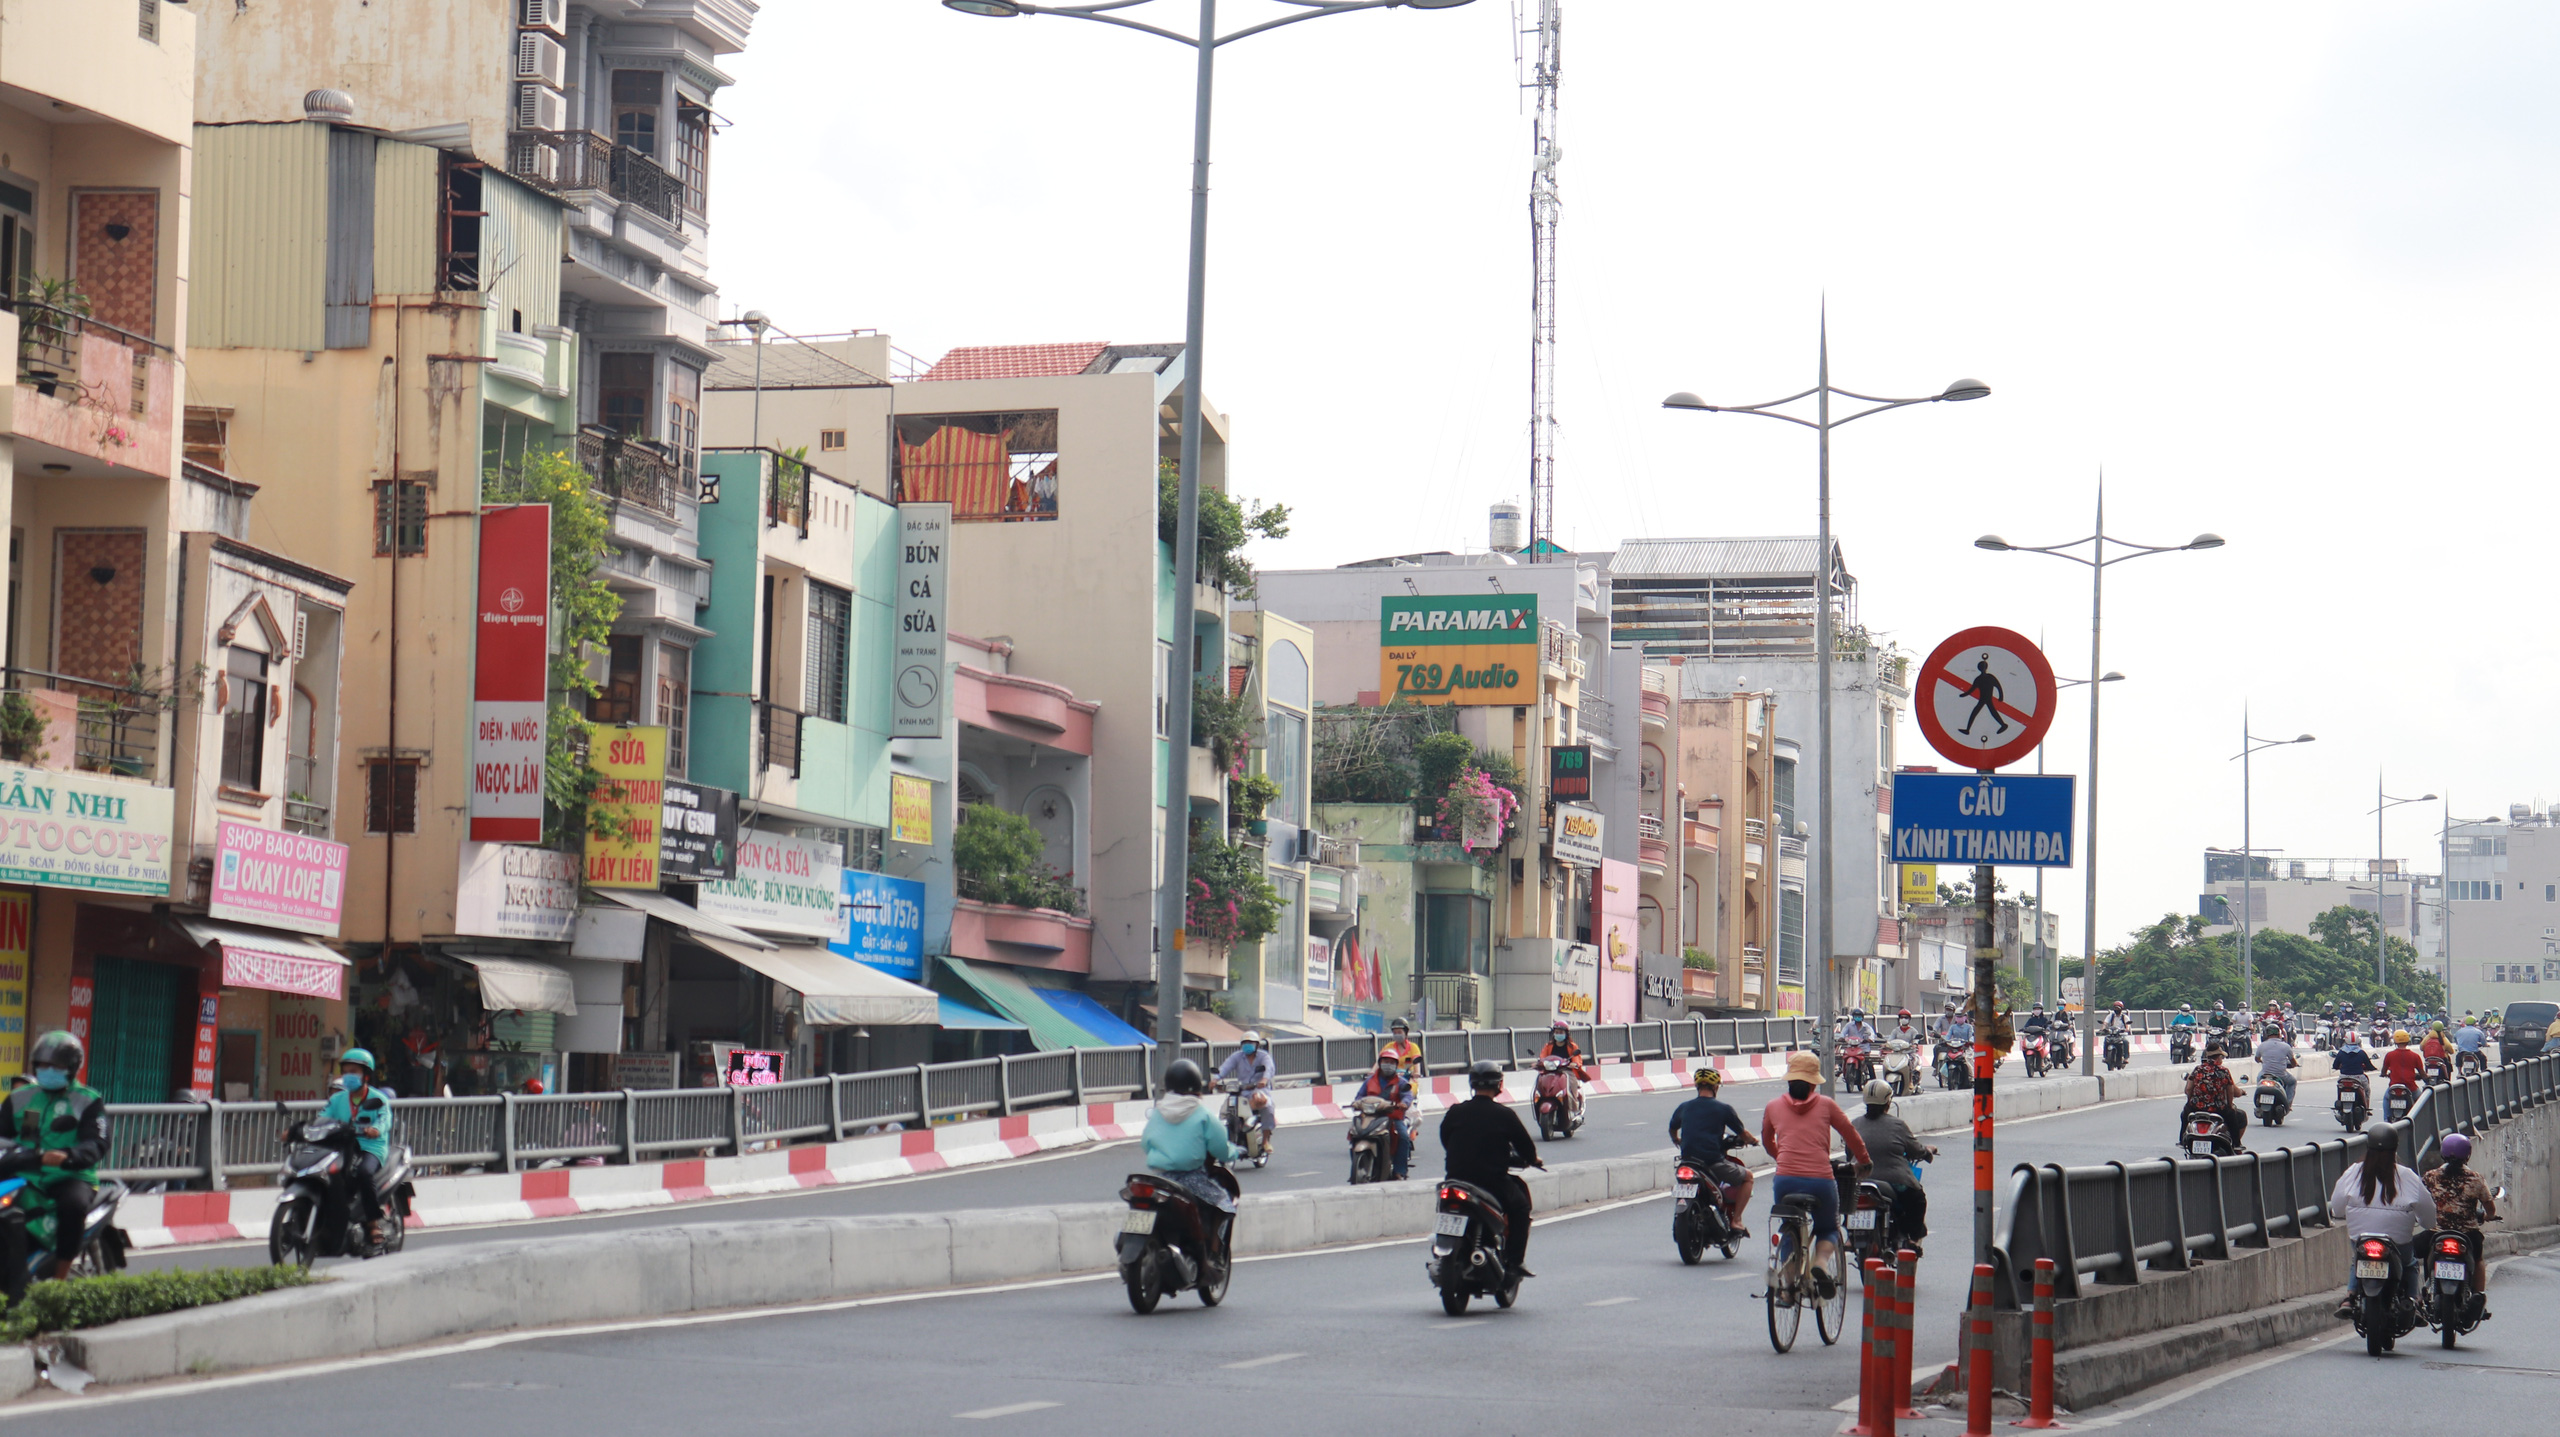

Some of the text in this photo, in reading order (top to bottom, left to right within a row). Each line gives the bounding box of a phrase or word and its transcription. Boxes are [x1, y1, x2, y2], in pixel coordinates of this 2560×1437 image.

[905, 540, 940, 563] BÚN
[910, 575, 932, 598] CÁ
[510, 614, 544, 626] quang
[903, 609, 936, 632] SỨA
[1389, 608, 1527, 632] PARAMAX
[1389, 650, 1417, 661] ĐẠI LÝ
[1397, 663, 1519, 691] 769 Audio
[479, 717, 538, 747] ĐIỆN NƯỚC
[609, 732, 645, 765] SỬA
[1558, 751, 1583, 769] 769
[475, 757, 538, 803] NGỌC LÂN
[624, 779, 661, 811] THOẠI
[1553, 777, 1588, 794] AUDIO
[66, 791, 126, 821] NHI
[1959, 776, 2006, 816] CẦU
[686, 810, 716, 836] GSM
[226, 826, 342, 868] SHOP BAO CAO SU
[765, 841, 781, 872] CÁ
[785, 844, 810, 877] SỨA
[1952, 829, 2031, 860] THANH
[2034, 832, 2065, 862] ĐA
[29, 856, 55, 869] SCAN
[64, 858, 91, 873] ĐÓNG
[94, 862, 119, 876] SÁCH
[128, 863, 140, 878] ÉP
[241, 857, 322, 903] OKAY LOVE
[589, 848, 616, 882] LẤY
[764, 876, 782, 903] BÚN
[785, 886, 803, 908] NEM
[893, 897, 919, 930] 757a
[0, 964, 22, 981] MÀU
[228, 952, 338, 994] SHOP BAO CAO SU
[71, 985, 91, 1008] SHOP
[1573, 992, 1592, 1013] Audio
[200, 1027, 212, 1042] GEL
[276, 1008, 318, 1039] NƯỚC
[281, 1045, 312, 1076] DÂN
